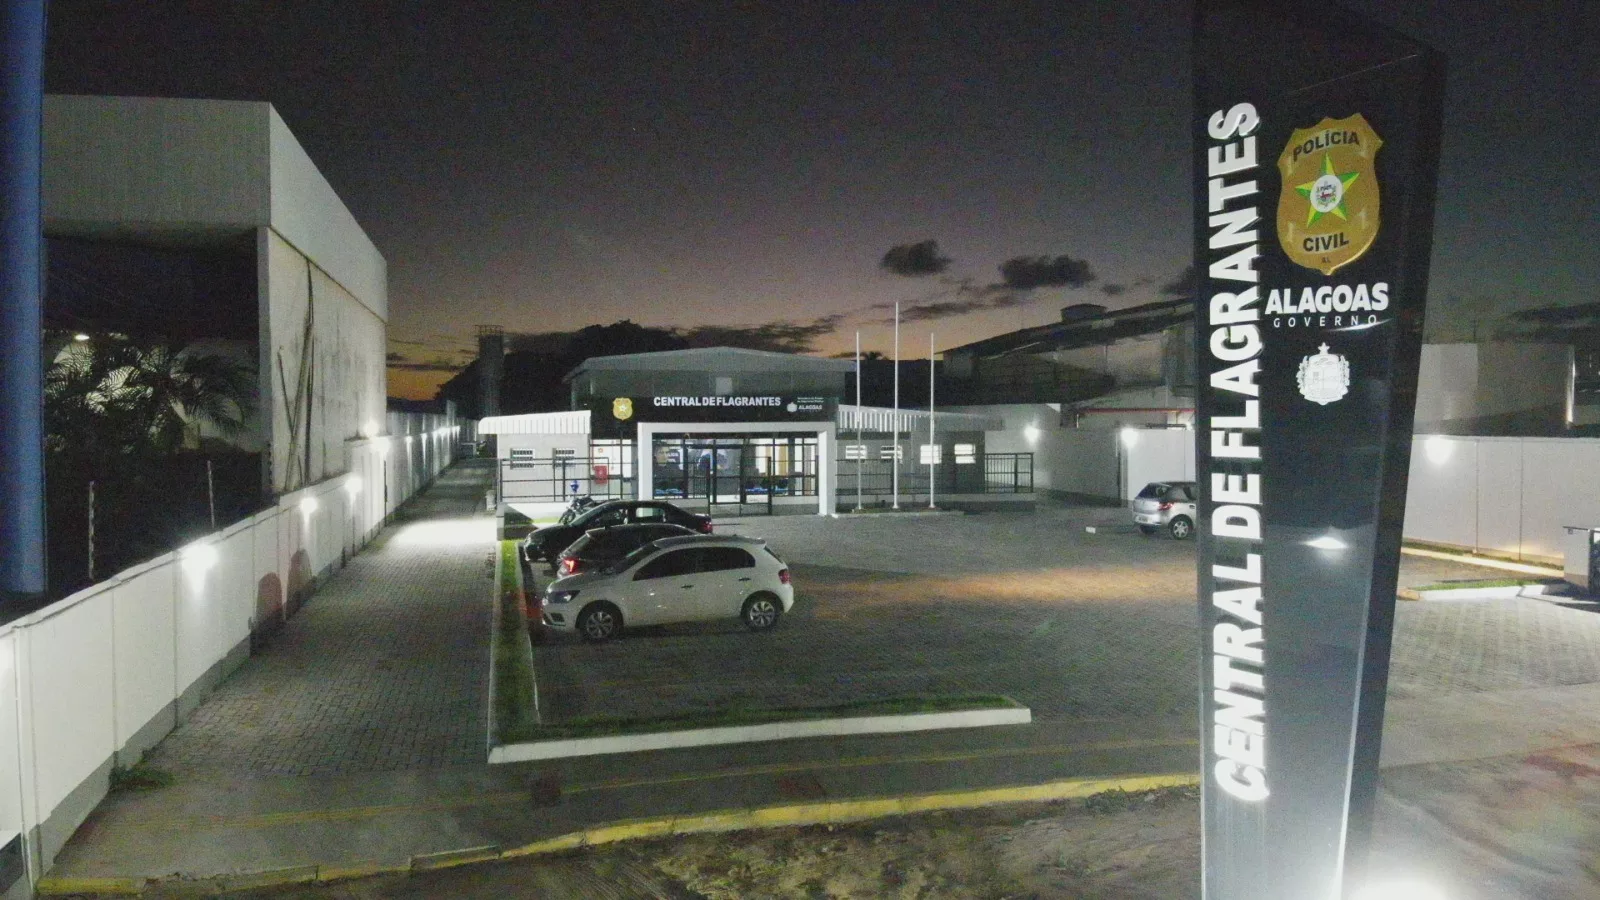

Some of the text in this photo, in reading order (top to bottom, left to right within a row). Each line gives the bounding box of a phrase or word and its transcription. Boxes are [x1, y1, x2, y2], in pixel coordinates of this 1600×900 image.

[1293, 130, 1360, 162] POLÍCIA
[1303, 233, 1349, 253] CIVIL
[1265, 283, 1389, 315] ALAGOAS
[1273, 314, 1378, 328] GOVERNO
[654, 397, 781, 406] CENTRAL DE FLAGRANTES
[1208, 102, 1270, 801] CENTRAL DE FLAGRANTES
